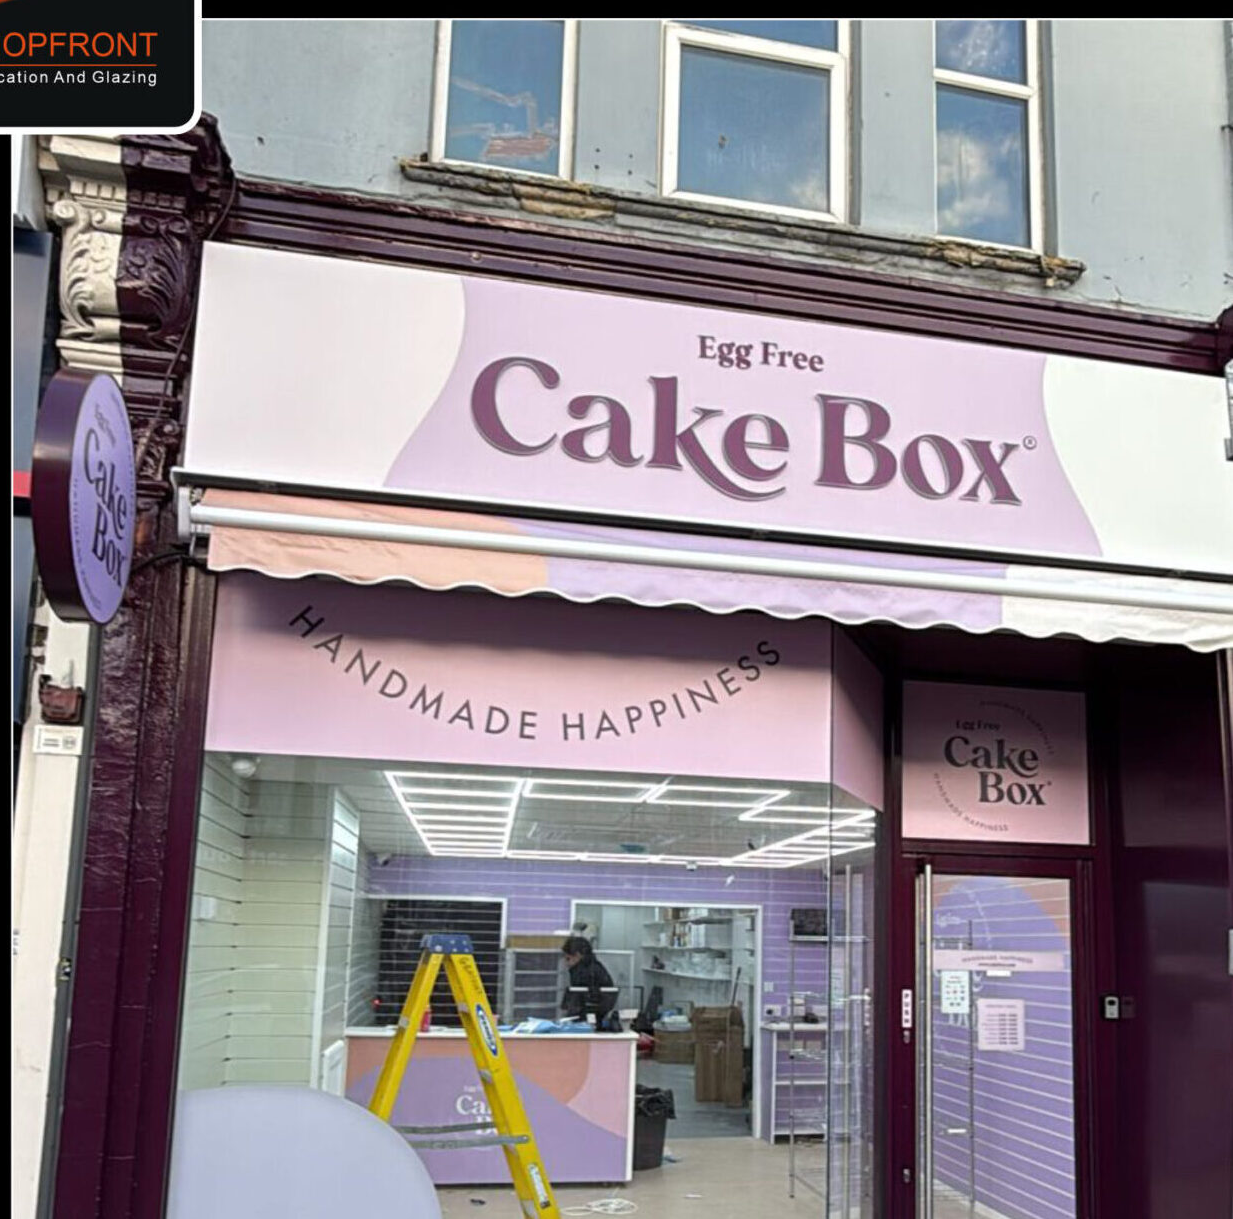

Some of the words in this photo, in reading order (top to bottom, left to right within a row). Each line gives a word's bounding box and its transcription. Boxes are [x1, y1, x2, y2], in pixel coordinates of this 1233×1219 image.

[697, 335, 752, 370] Egg
[761, 342, 824, 373] Free
[470, 355, 790, 503] Cake
[84, 428, 127, 540] Cake
[92, 502, 126, 588] Box
[288, 604, 537, 741] HANDMADE
[562, 640, 782, 741] HAPPINESS
[944, 736, 1039, 778] Cake
